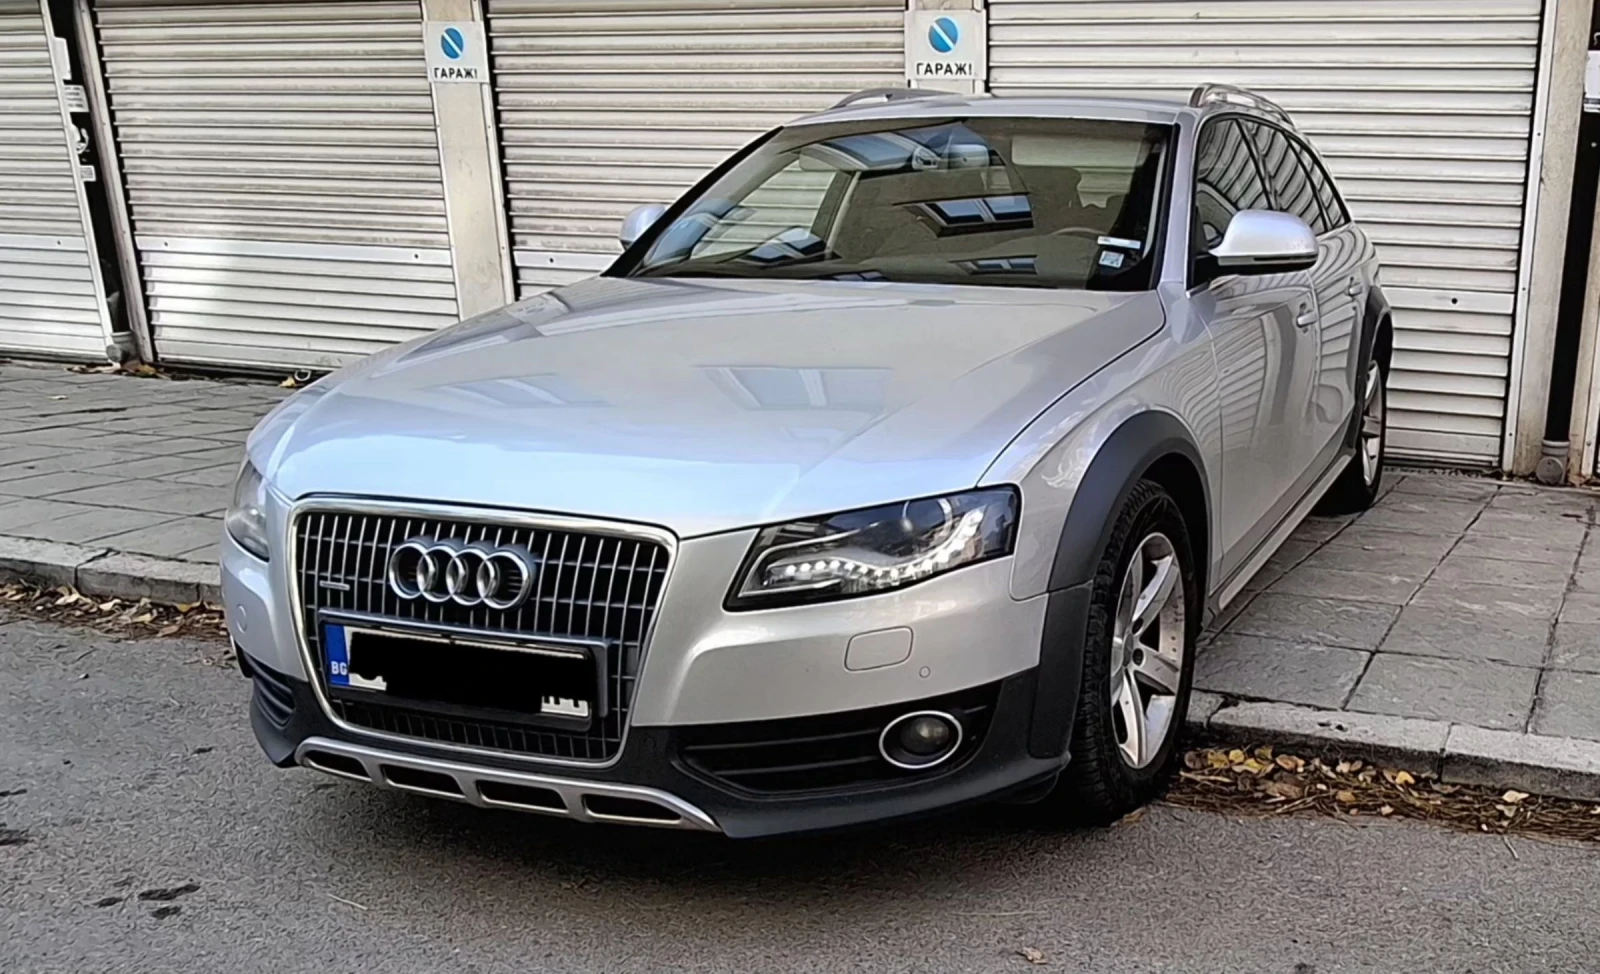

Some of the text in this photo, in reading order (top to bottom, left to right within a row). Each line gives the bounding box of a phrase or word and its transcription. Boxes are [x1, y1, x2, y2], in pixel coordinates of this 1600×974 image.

[433, 67, 478, 79] ГАРАЖ!
[916, 62, 973, 76] ГАРАЖ!
[331, 661, 348, 675] BG
